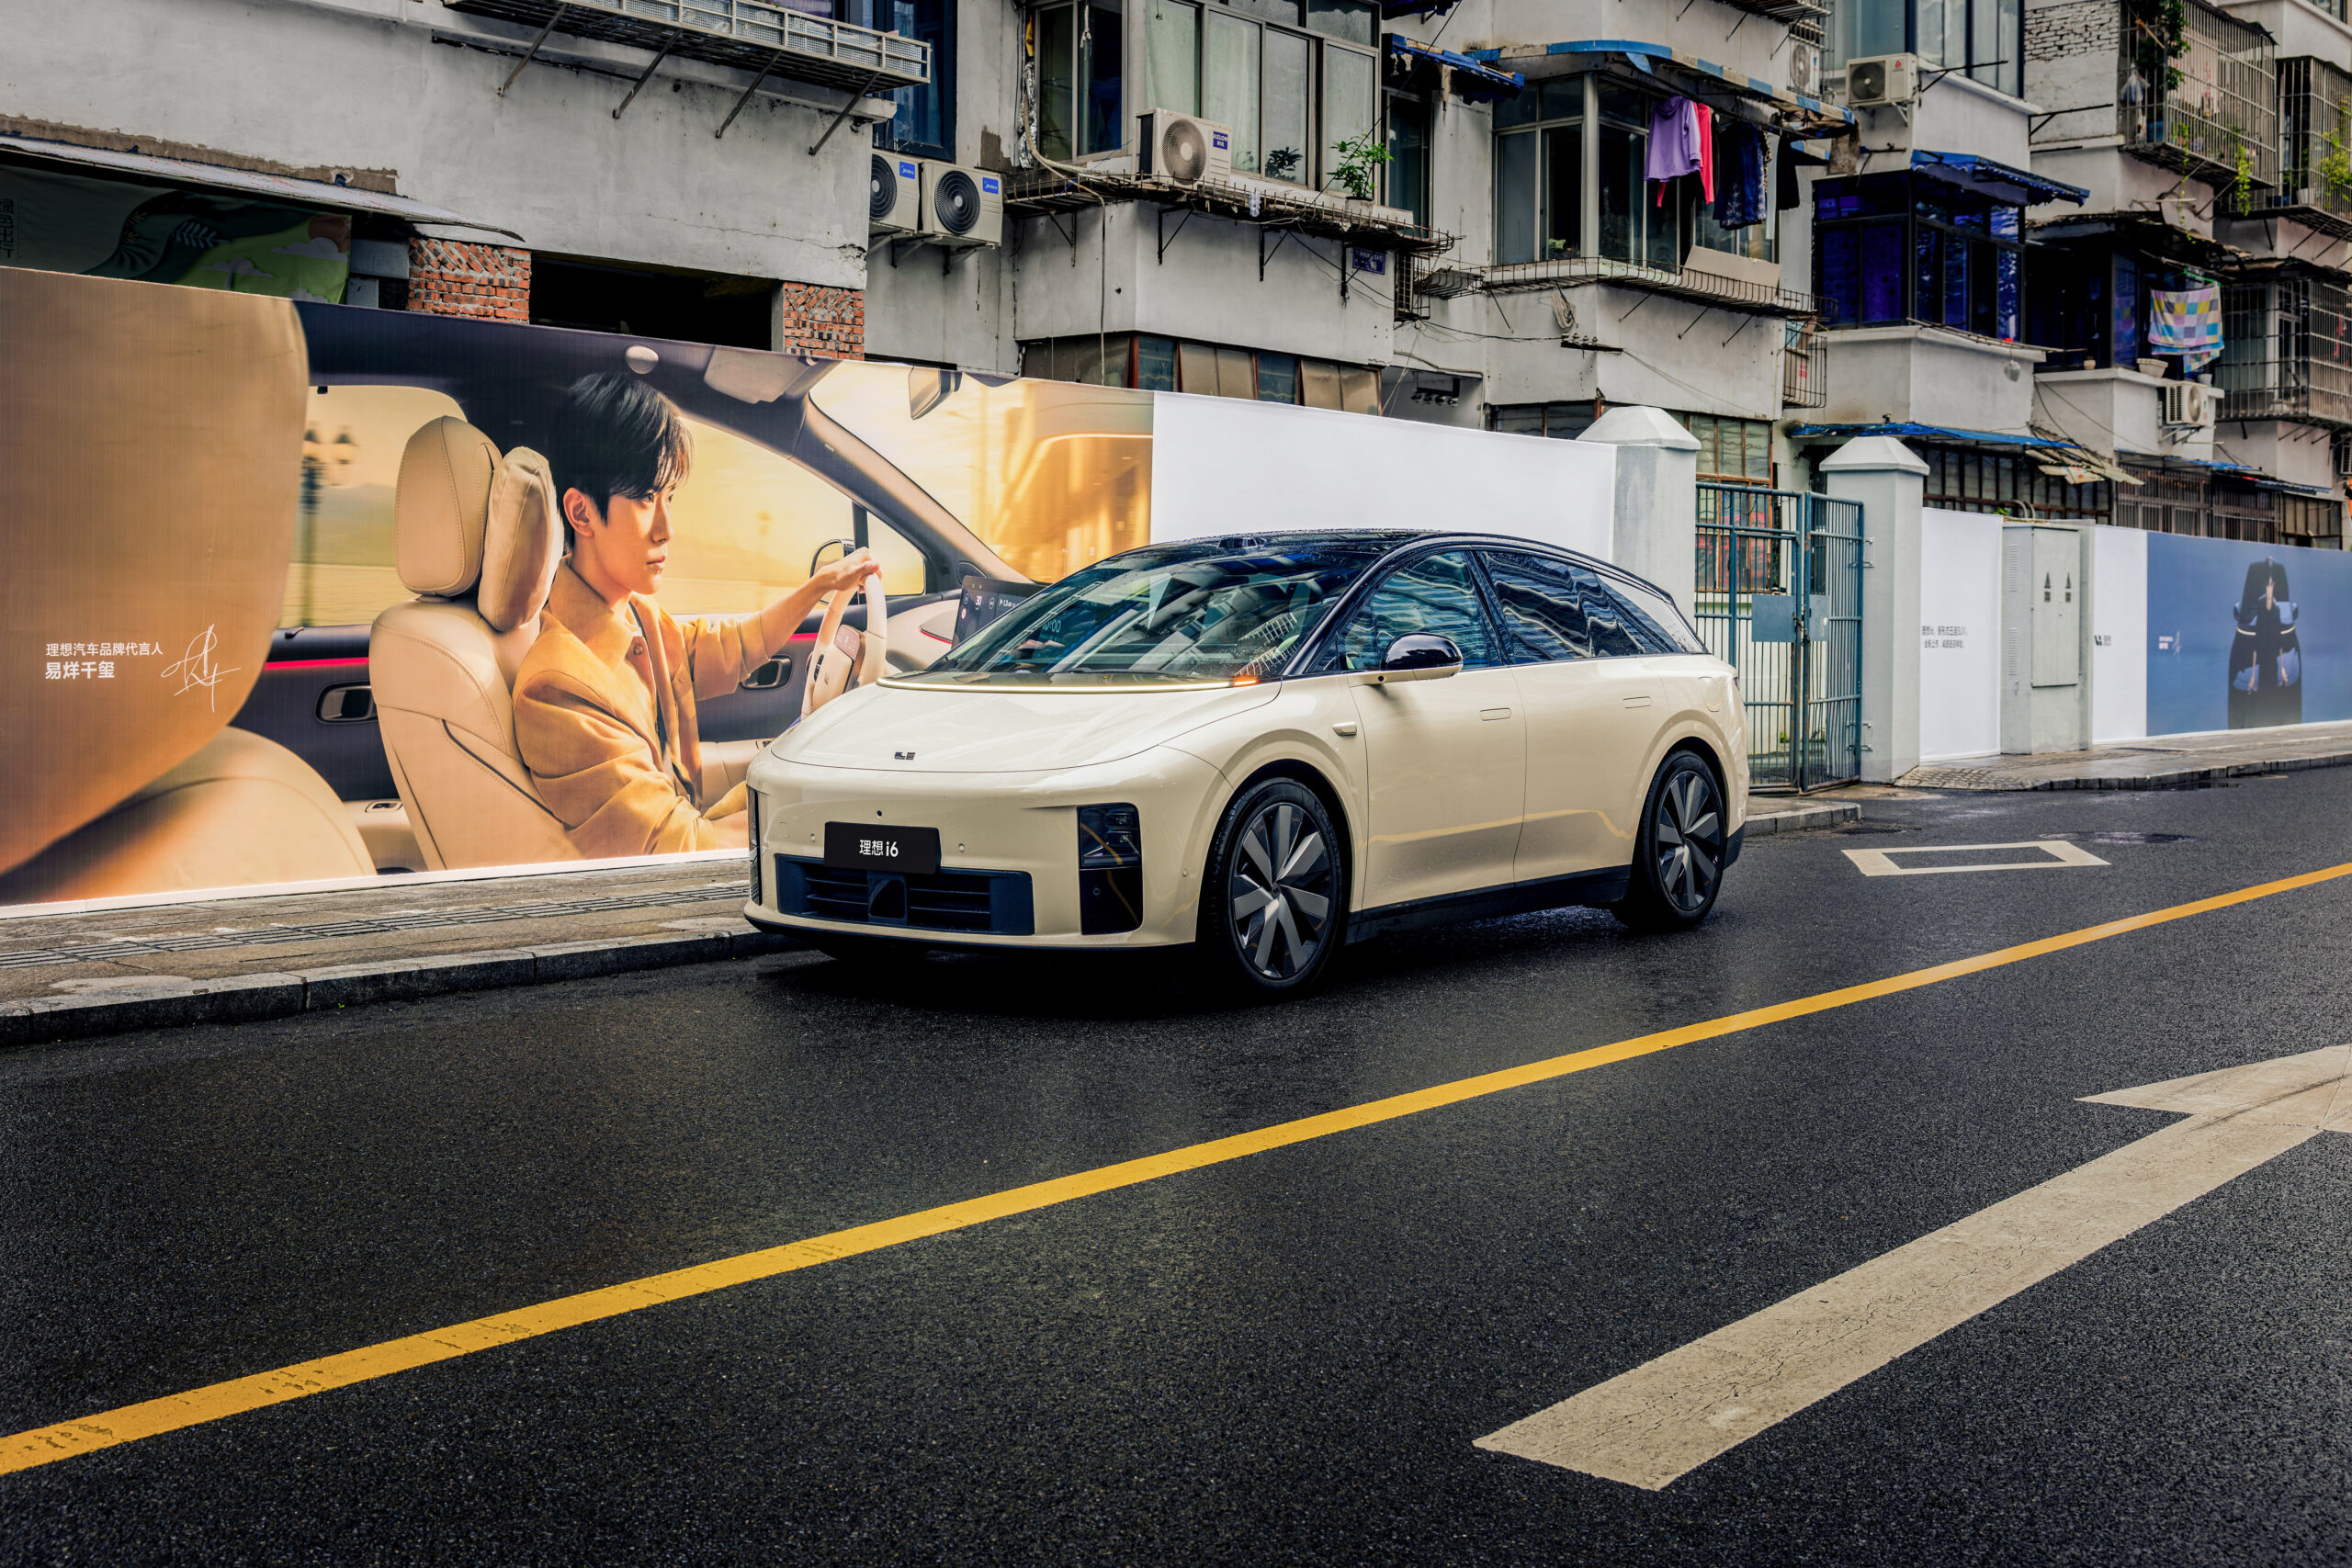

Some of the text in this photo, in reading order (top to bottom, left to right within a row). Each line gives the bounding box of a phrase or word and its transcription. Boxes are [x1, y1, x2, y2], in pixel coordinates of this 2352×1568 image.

[46, 642, 164, 657] 理想汽车品牌代言人
[45, 660, 116, 680] 易烊千玺
[859, 840, 899, 857] 理想 i6
